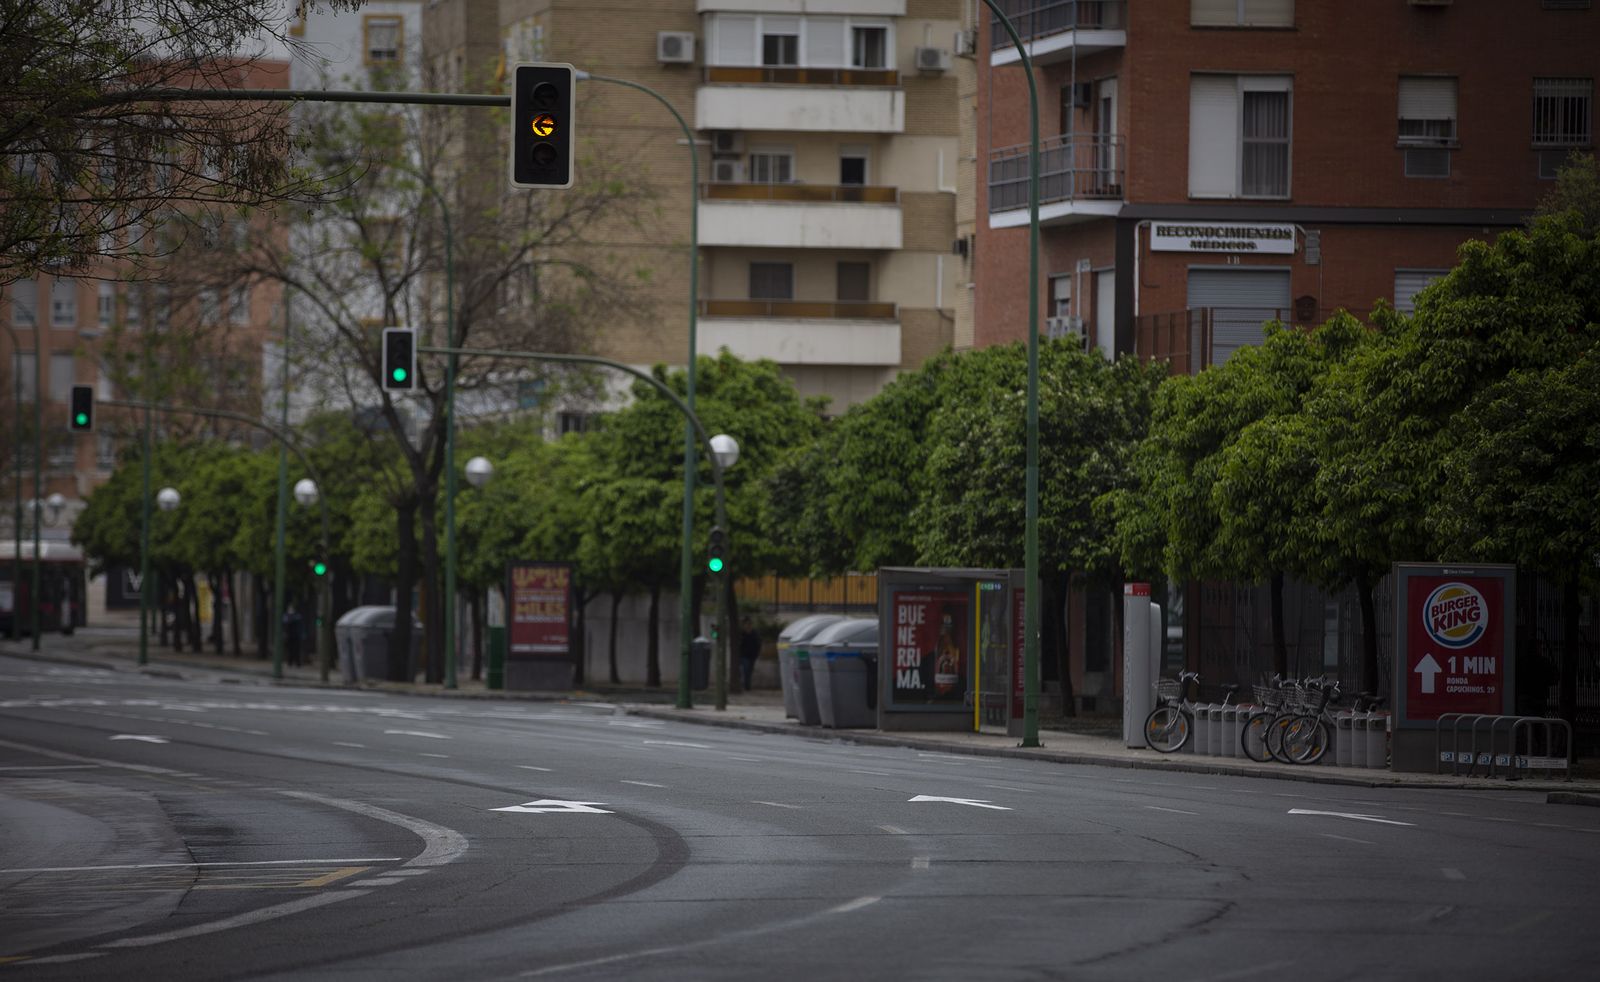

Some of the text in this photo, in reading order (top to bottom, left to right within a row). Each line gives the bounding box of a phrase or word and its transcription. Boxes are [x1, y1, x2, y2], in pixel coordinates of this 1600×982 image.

[1156, 225, 1292, 240] RECONOCIMIENTOS
[897, 605, 926, 624] BUE
[1431, 595, 1479, 617] BURGER
[1432, 606, 1481, 634] KING
[897, 647, 921, 667] RRI
[1448, 655, 1496, 675] 1 MIN
[896, 669, 926, 689] MA.
[1446, 677, 1469, 685] RONDA
